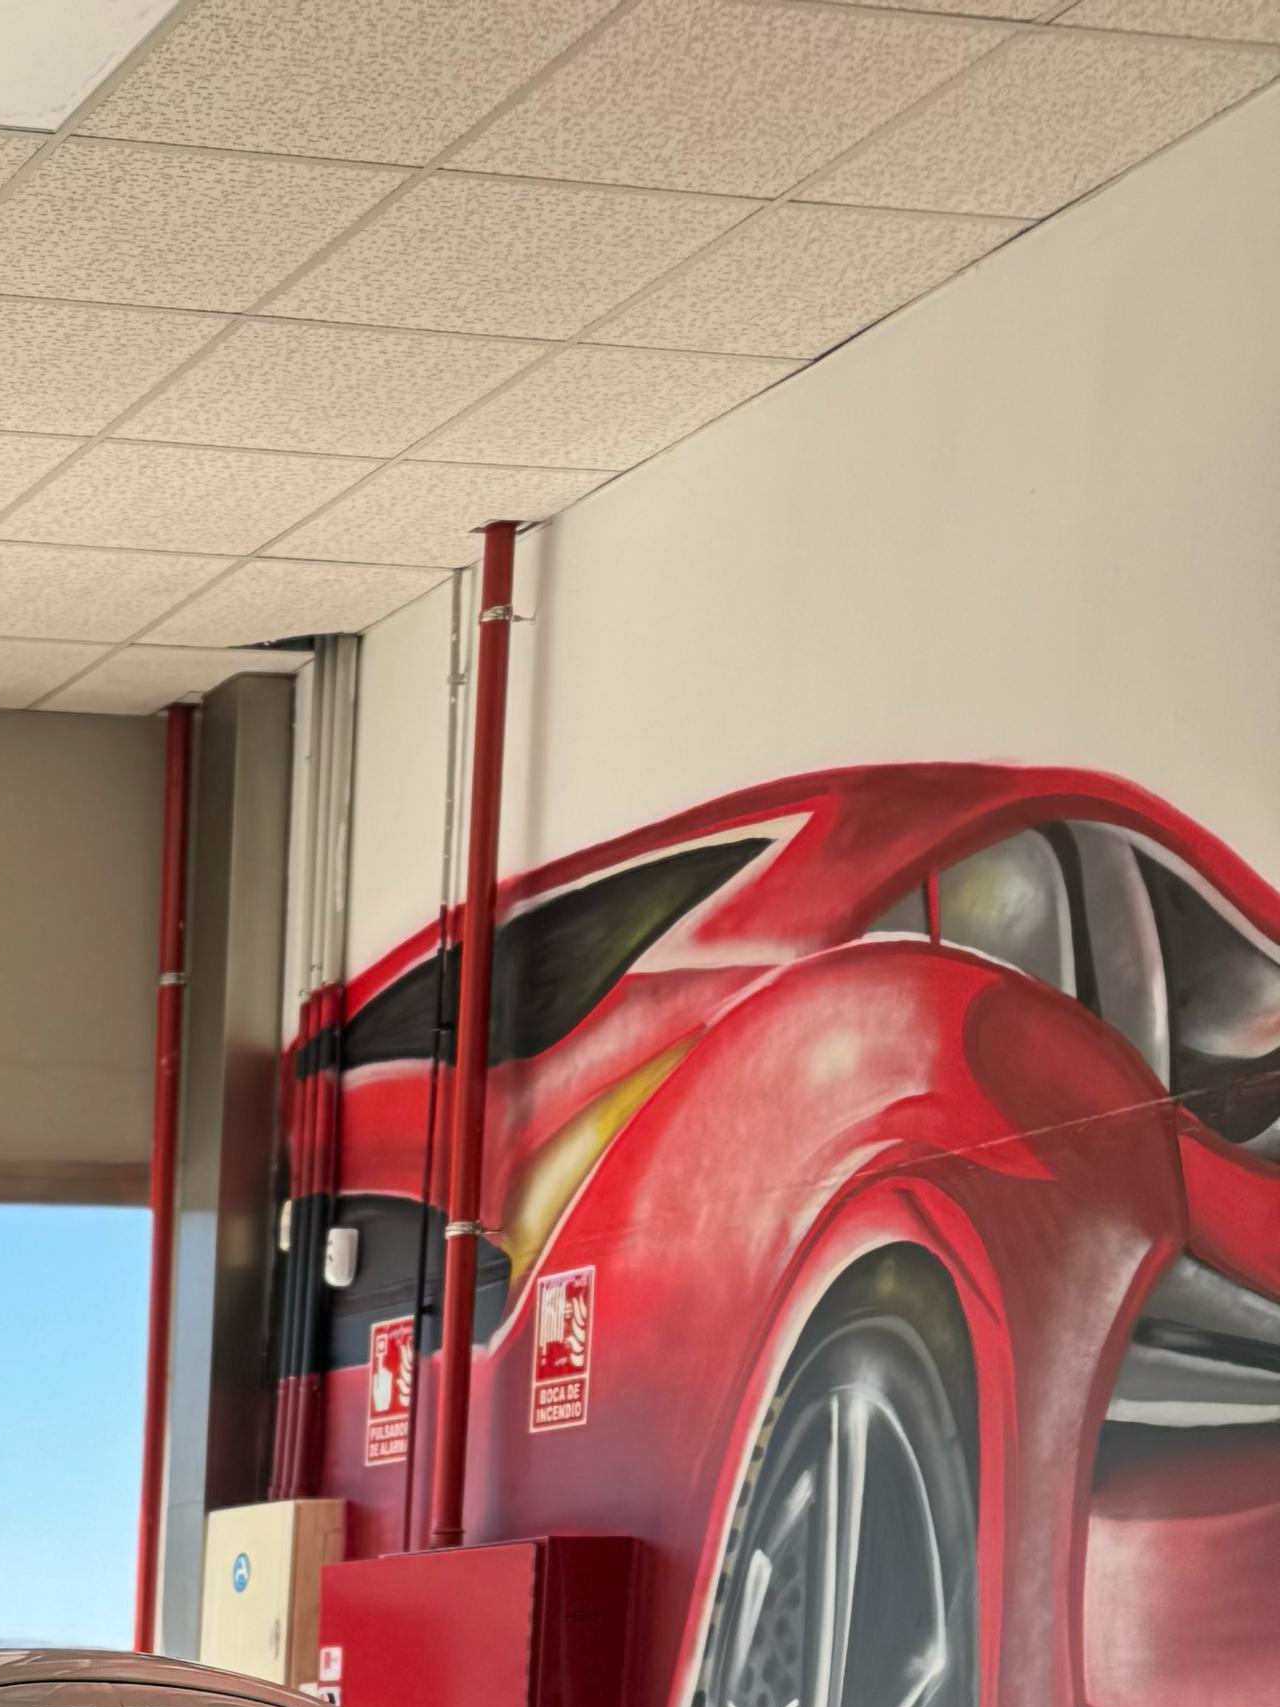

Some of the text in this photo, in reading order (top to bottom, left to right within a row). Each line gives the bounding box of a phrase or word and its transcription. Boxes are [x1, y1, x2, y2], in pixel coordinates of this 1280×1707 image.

[539, 1383, 581, 1406] BOCA DE
[536, 1401, 582, 1424] INCENDIO
